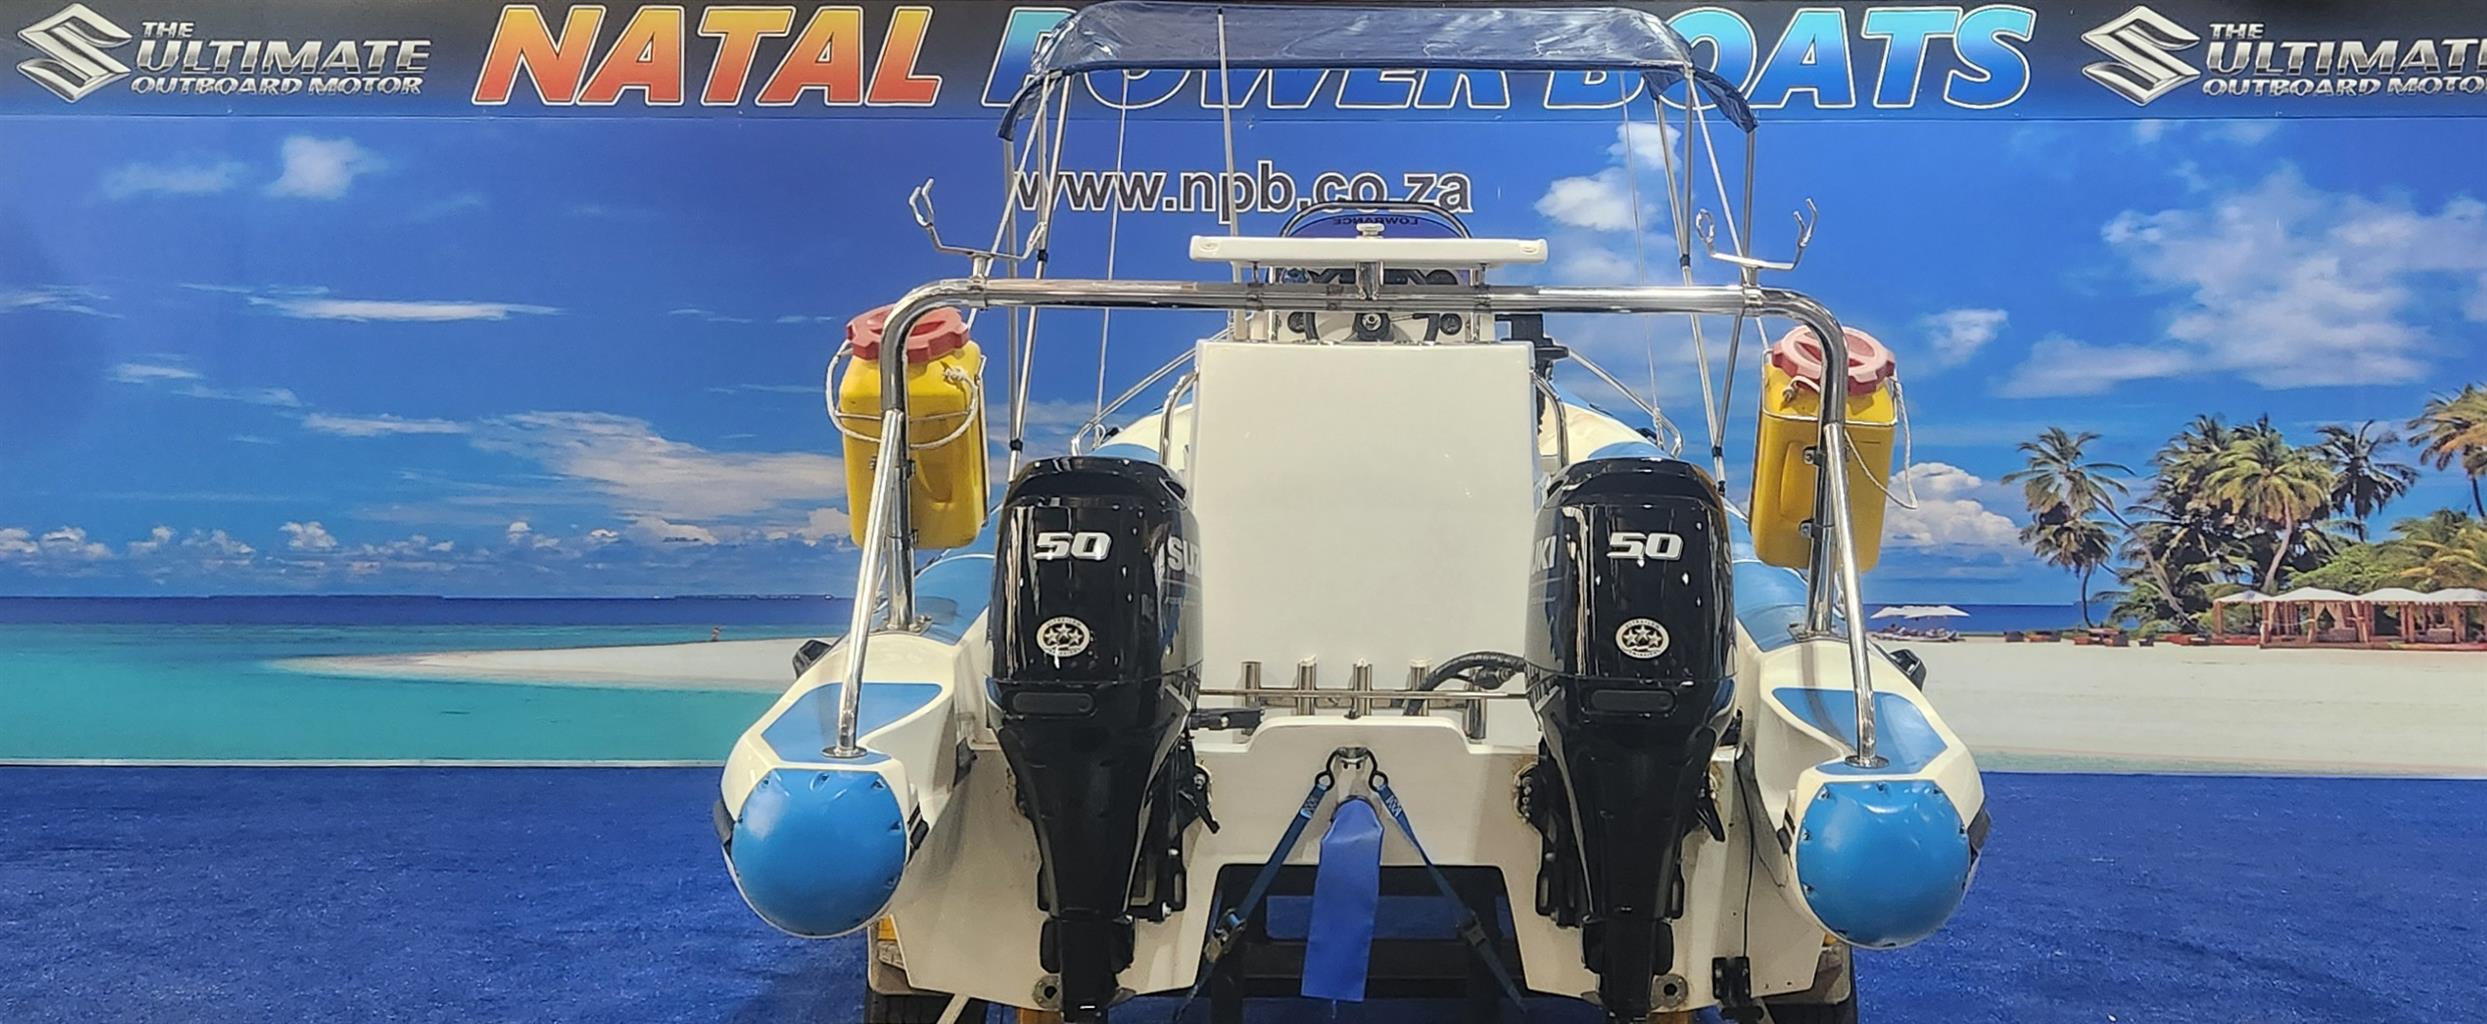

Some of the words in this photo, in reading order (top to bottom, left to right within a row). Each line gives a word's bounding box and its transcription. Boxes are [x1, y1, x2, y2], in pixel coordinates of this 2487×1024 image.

[142, 21, 194, 39] THE
[2209, 23, 2264, 39] THE
[136, 40, 431, 76] ULTIMATE
[471, 5, 943, 106] NATAL
[2205, 38, 2487, 76] ULTIMAT
[131, 75, 302, 96] OUTBOARD
[308, 75, 426, 96] MOTOR
[2202, 77, 2380, 97] OUTBOARD
[2387, 75, 2487, 96] MOTO
[1034, 532, 1112, 560] 50
[1606, 532, 1684, 560] 50
